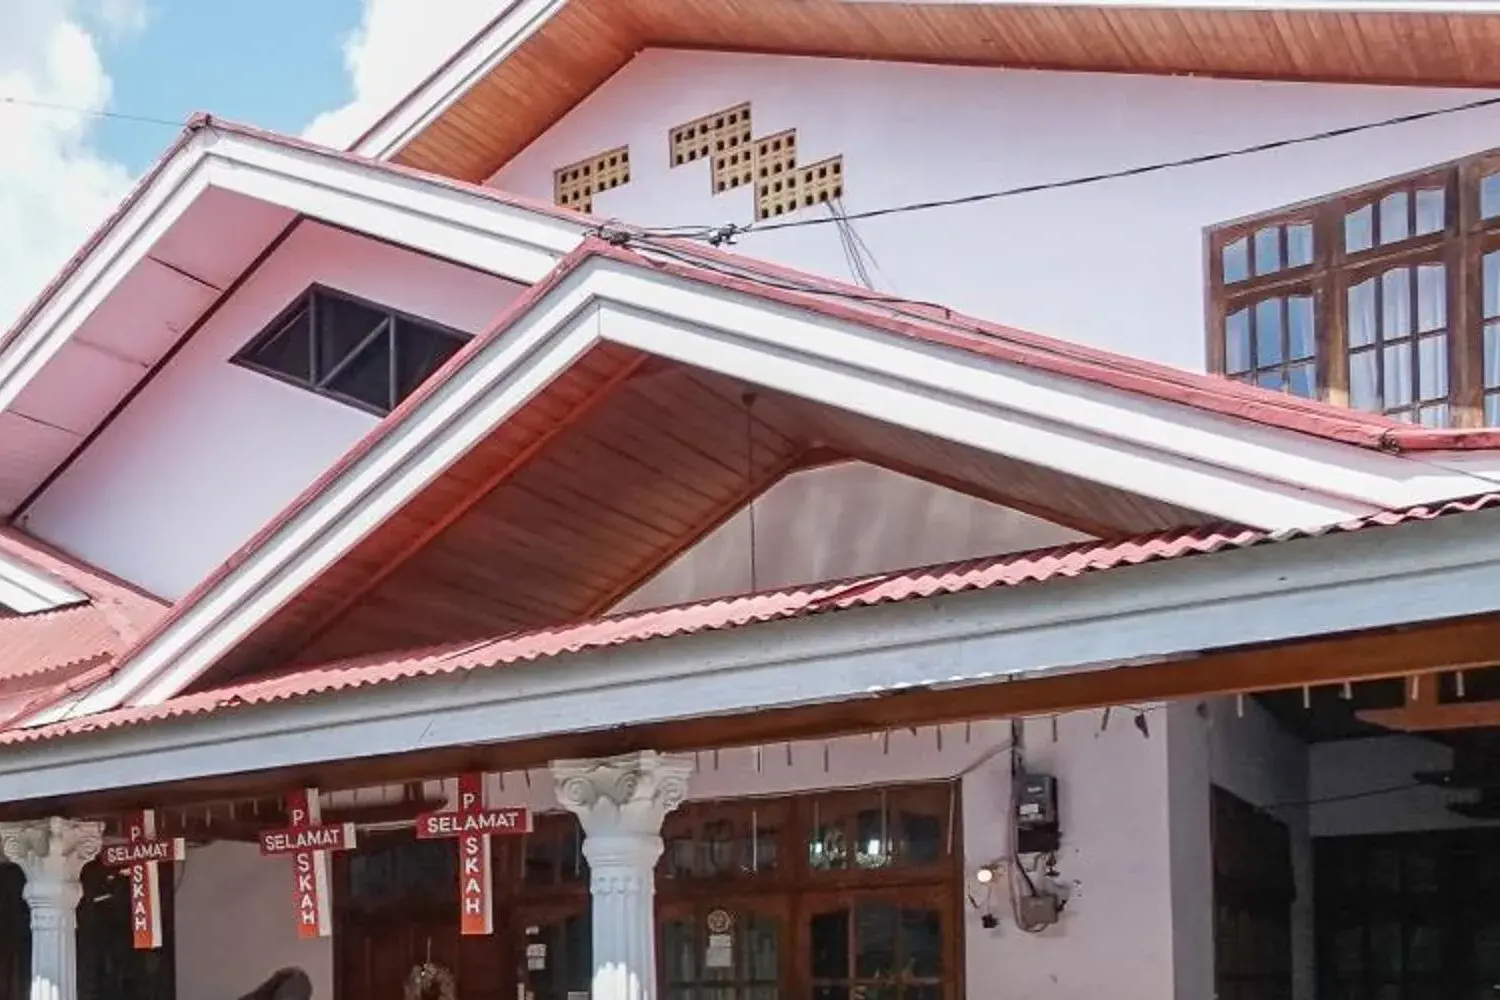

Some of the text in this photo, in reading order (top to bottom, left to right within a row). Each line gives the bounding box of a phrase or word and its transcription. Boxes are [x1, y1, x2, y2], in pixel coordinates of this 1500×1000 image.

[427, 812, 518, 833] SELAMAT
[265, 829, 339, 850] SELAMAT
[108, 843, 168, 862] SELAMAT
